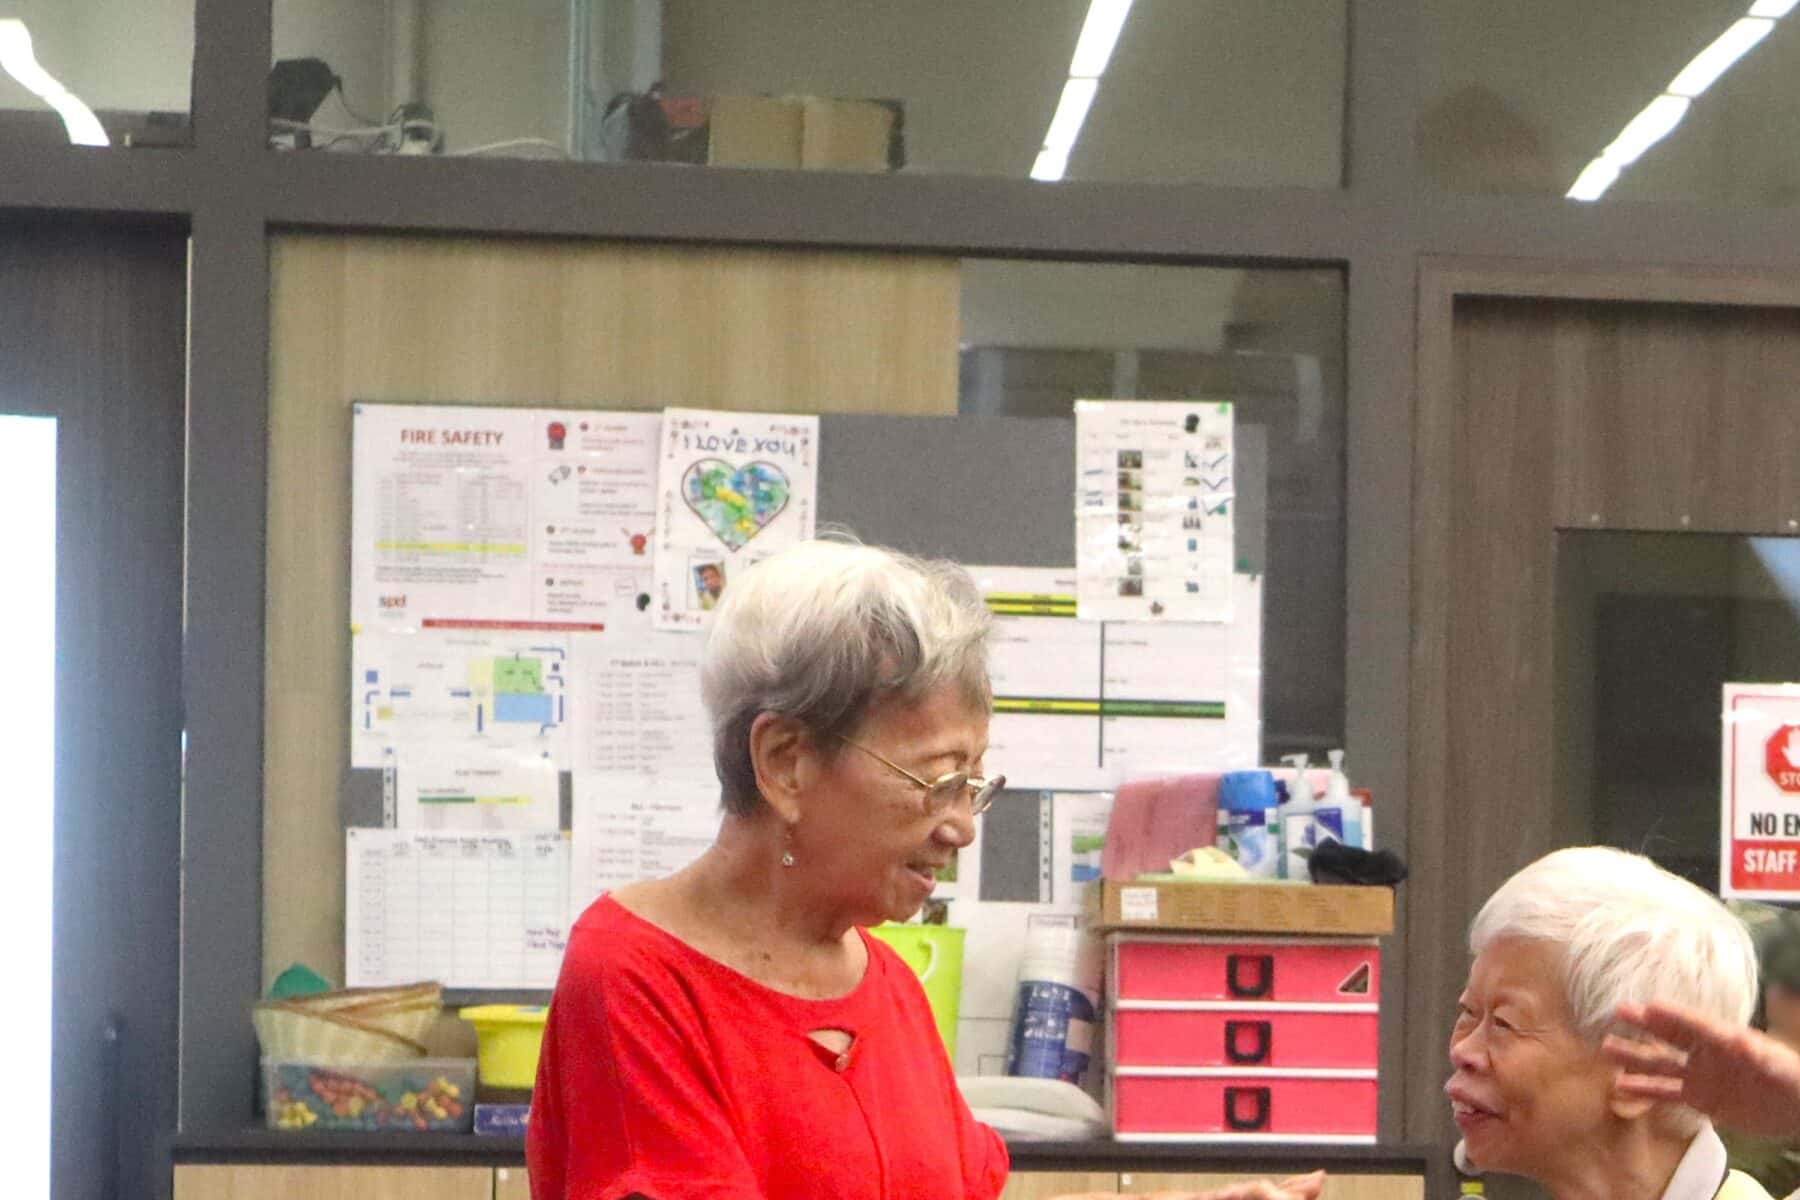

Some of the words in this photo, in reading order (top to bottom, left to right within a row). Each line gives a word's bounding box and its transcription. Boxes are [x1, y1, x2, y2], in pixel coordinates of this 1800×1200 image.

[400, 429, 434, 445] FIRE
[441, 430, 505, 447] SAFETY
[696, 434, 748, 454] LOVE
[1750, 814, 1777, 836] NO
[1744, 850, 1797, 873] STAFF
